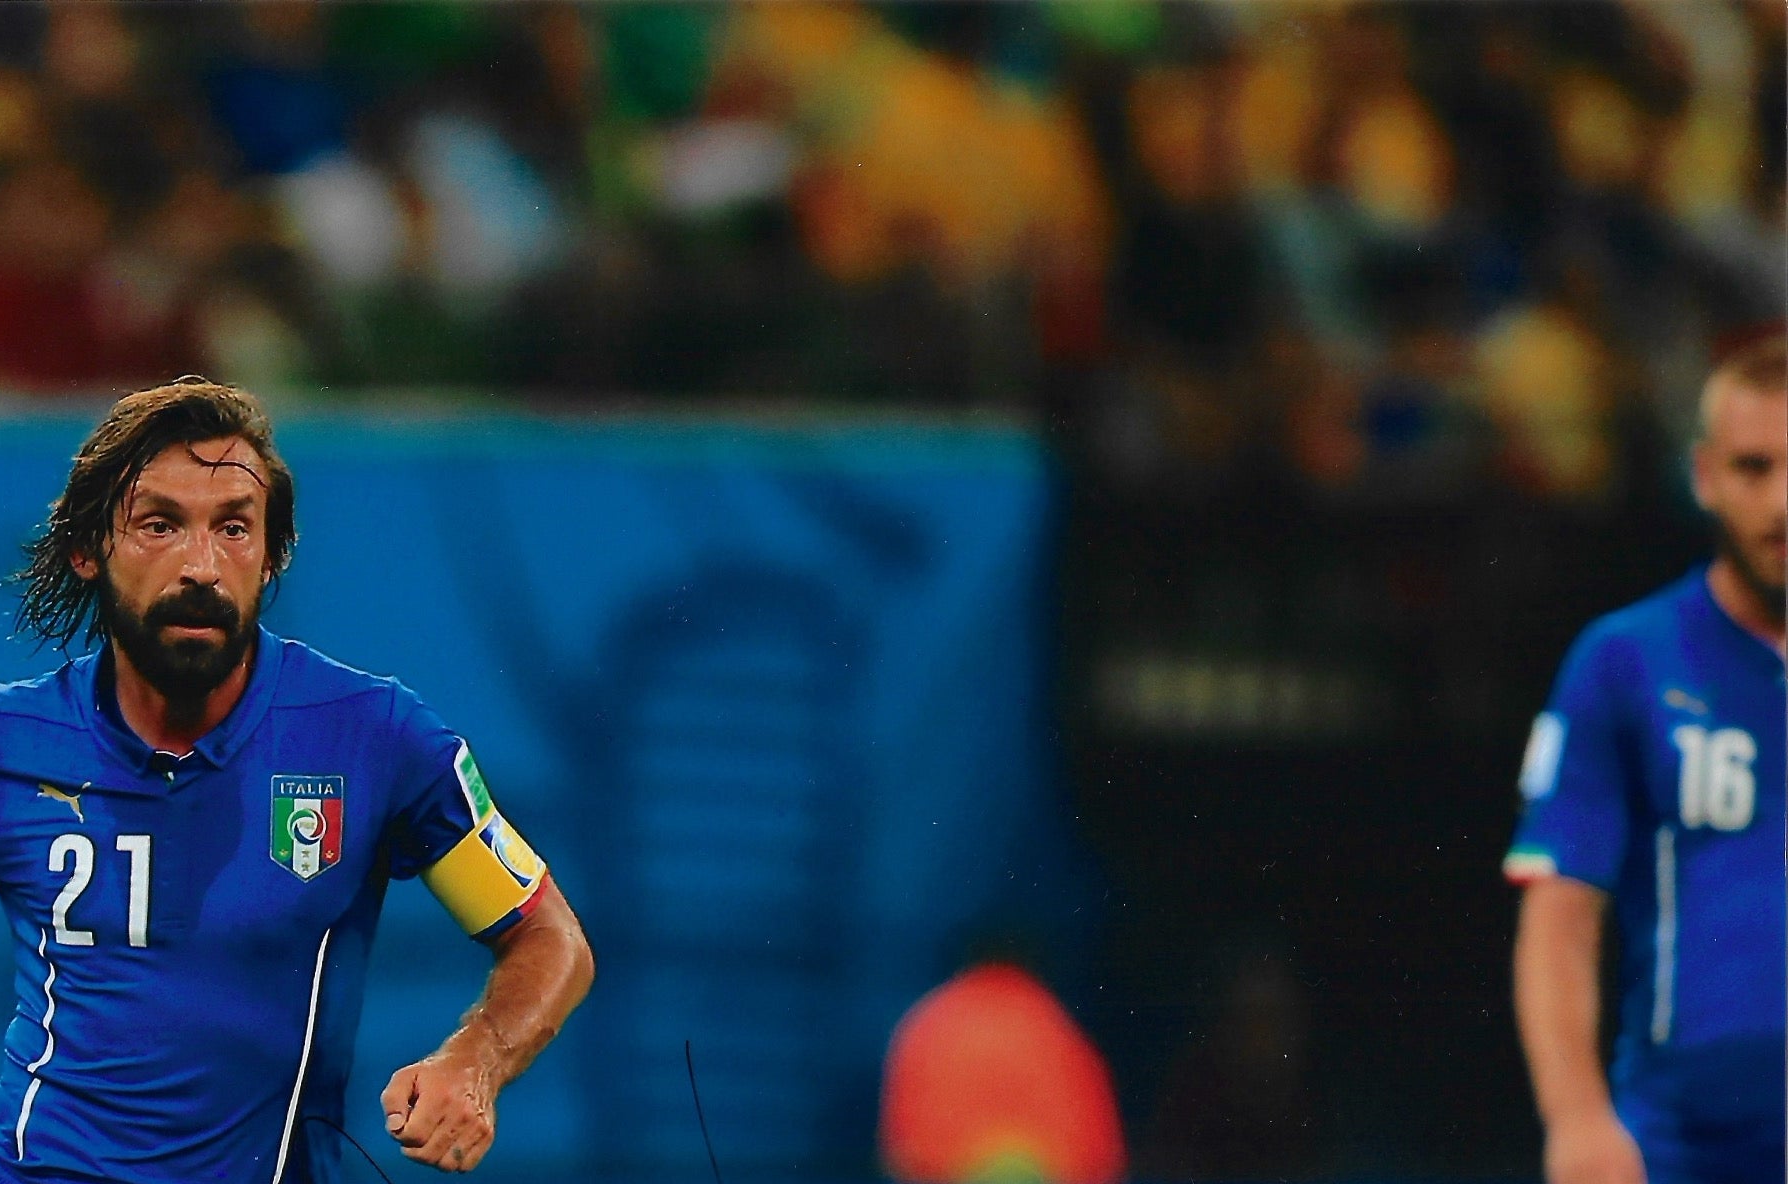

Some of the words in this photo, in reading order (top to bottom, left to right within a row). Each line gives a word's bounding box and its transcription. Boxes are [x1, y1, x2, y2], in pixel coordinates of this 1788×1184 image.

[280, 782, 334, 795] ITALIA
[1671, 723, 1757, 831] 16
[48, 834, 152, 948] 21
